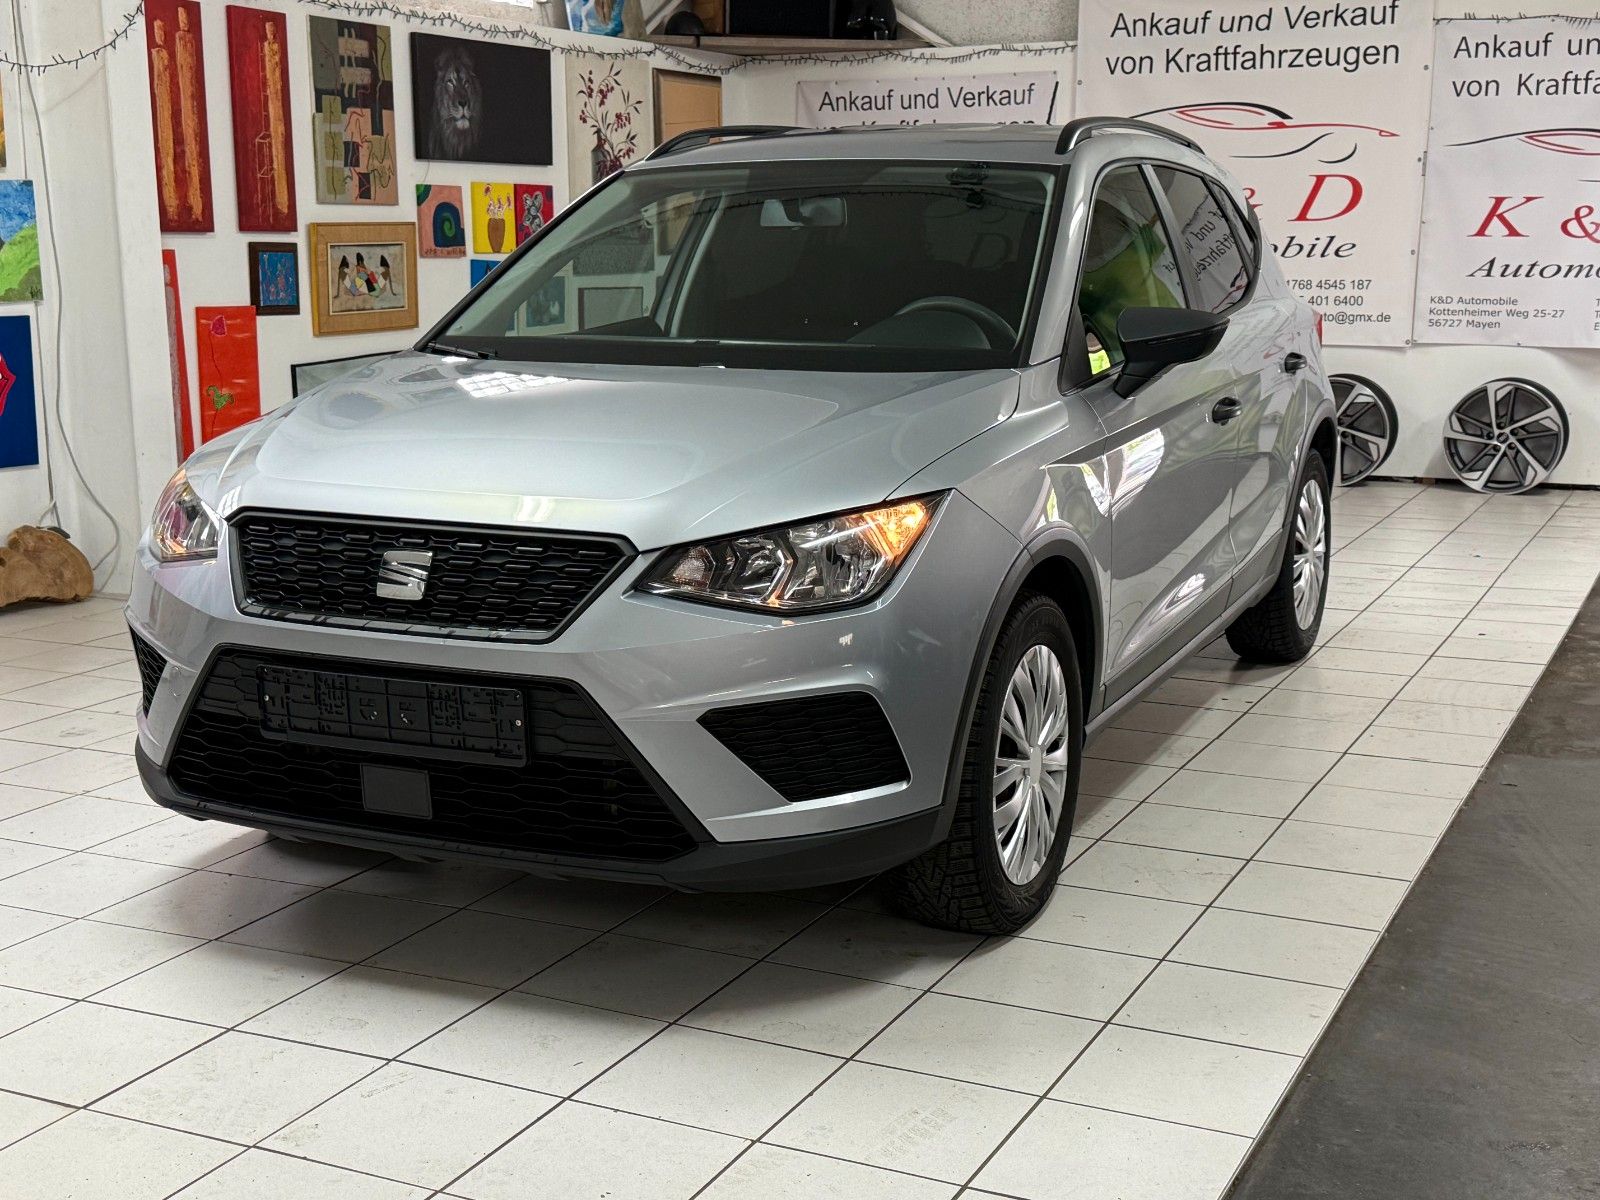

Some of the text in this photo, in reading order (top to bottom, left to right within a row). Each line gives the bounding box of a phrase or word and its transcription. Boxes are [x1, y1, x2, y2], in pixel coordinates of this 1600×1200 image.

[1109, 0, 1400, 38] Ankauf und Verkauf
[1453, 31, 1554, 59] Ankauf
[1105, 43, 1400, 76] von Kraftfahrzeugen
[817, 82, 1036, 112] Ankauf und Verkauf
[1451, 79, 1500, 98] von
[1287, 174, 1363, 222] D
[1467, 196, 1544, 238] K
[1466, 256, 1600, 279] Autom
[1315, 279, 1346, 291] 4545
[1350, 279, 1373, 291] 187
[1307, 295, 1364, 307] 401 6400
[1429, 295, 1519, 306] K&D Automobile
[1321, 311, 1392, 325] to@gmx.de
[1428, 306, 1565, 320] Kottenheimer Weg 25-27
[1427, 318, 1501, 330] 56727 Mayen
